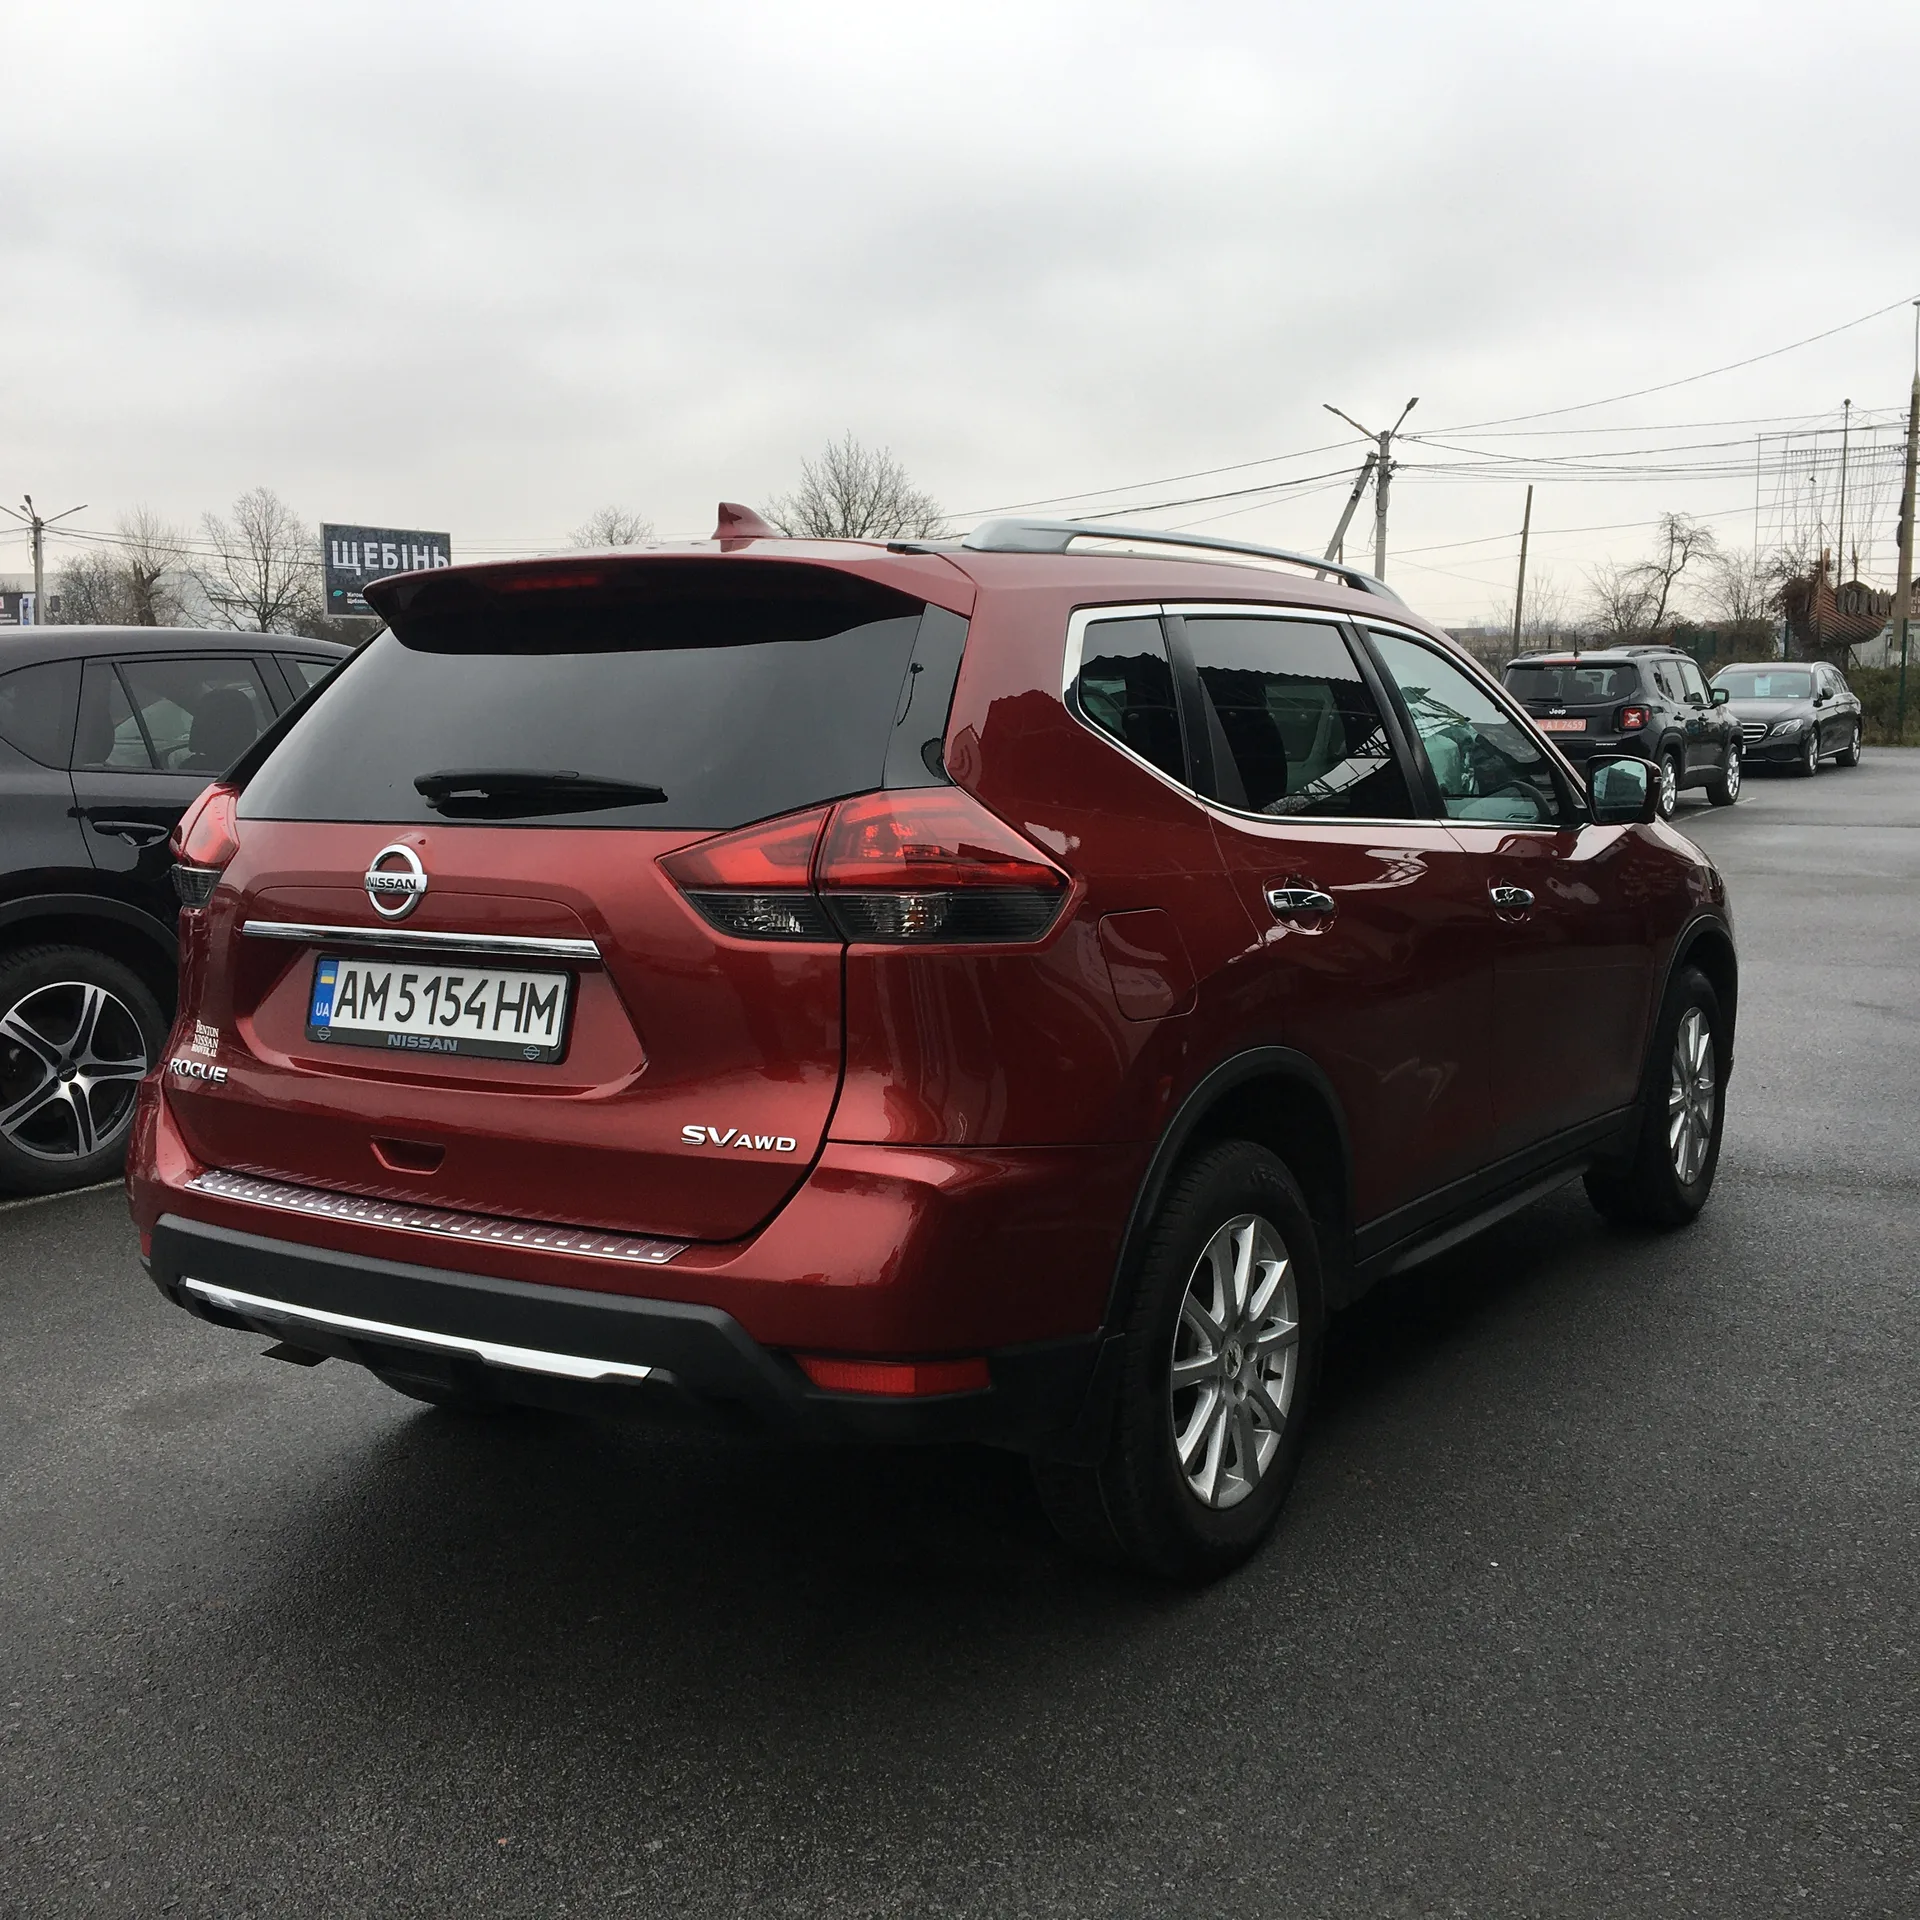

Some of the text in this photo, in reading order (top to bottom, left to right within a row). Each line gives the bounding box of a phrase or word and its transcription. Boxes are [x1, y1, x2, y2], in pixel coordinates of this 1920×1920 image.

[331, 540, 449, 576] ЩЕБІНЬ
[1562, 720, 1583, 729] 7459
[366, 876, 417, 889] NISSAN
[315, 1002, 329, 1017] UA
[334, 970, 559, 1035] AM 5154 HM
[195, 1019, 219, 1037] BENTON
[193, 1033, 219, 1049] NISSAN
[387, 1034, 458, 1051] NISSAN
[169, 1057, 228, 1083] ROGUE
